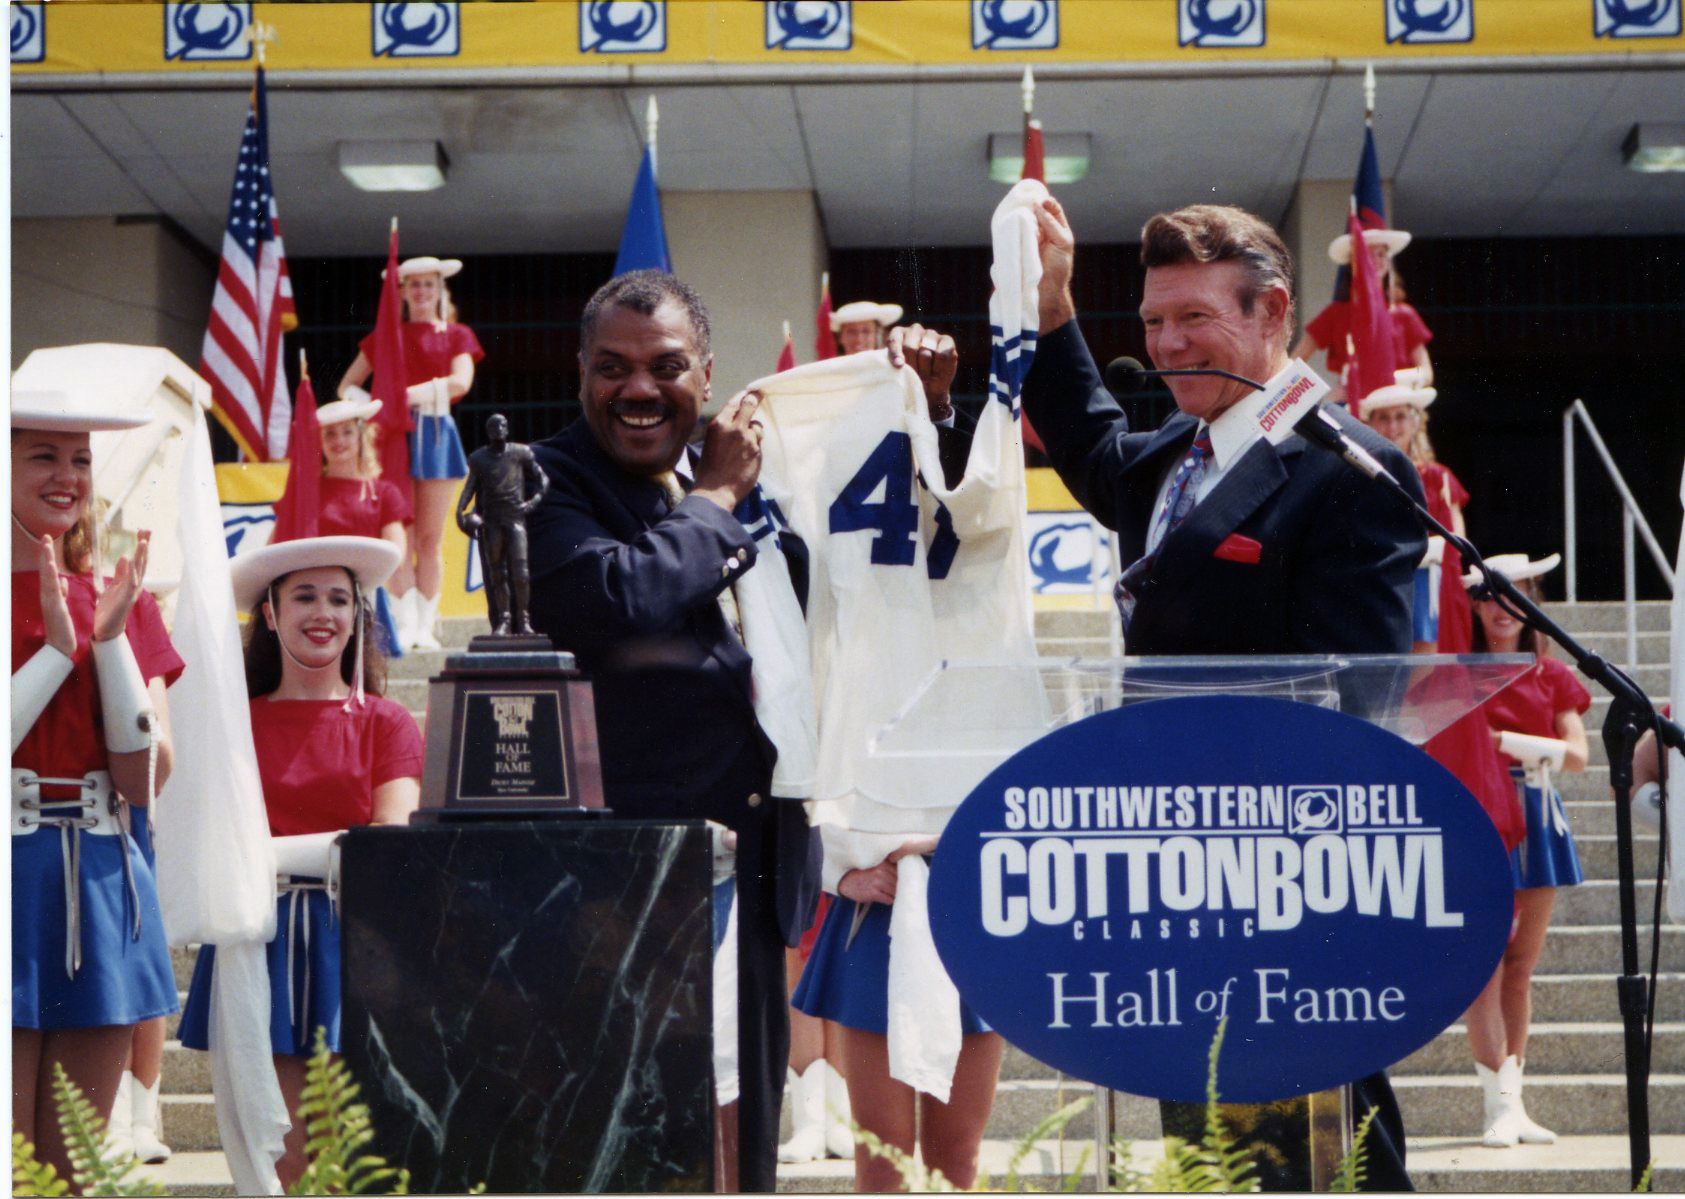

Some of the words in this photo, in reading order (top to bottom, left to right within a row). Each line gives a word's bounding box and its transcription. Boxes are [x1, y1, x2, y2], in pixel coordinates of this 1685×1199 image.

[496, 743, 530, 754] HALL
[505, 754, 518, 762] OF
[495, 762, 531, 773] FAME
[1004, 785, 1284, 830] SOUTHWESTERN
[1347, 784, 1423, 827] BELL
[1074, 919, 1255, 940] CLASSIC
[1047, 968, 1182, 1028] Hall
[1195, 977, 1237, 1021] of
[1254, 968, 1406, 1023] Fame
